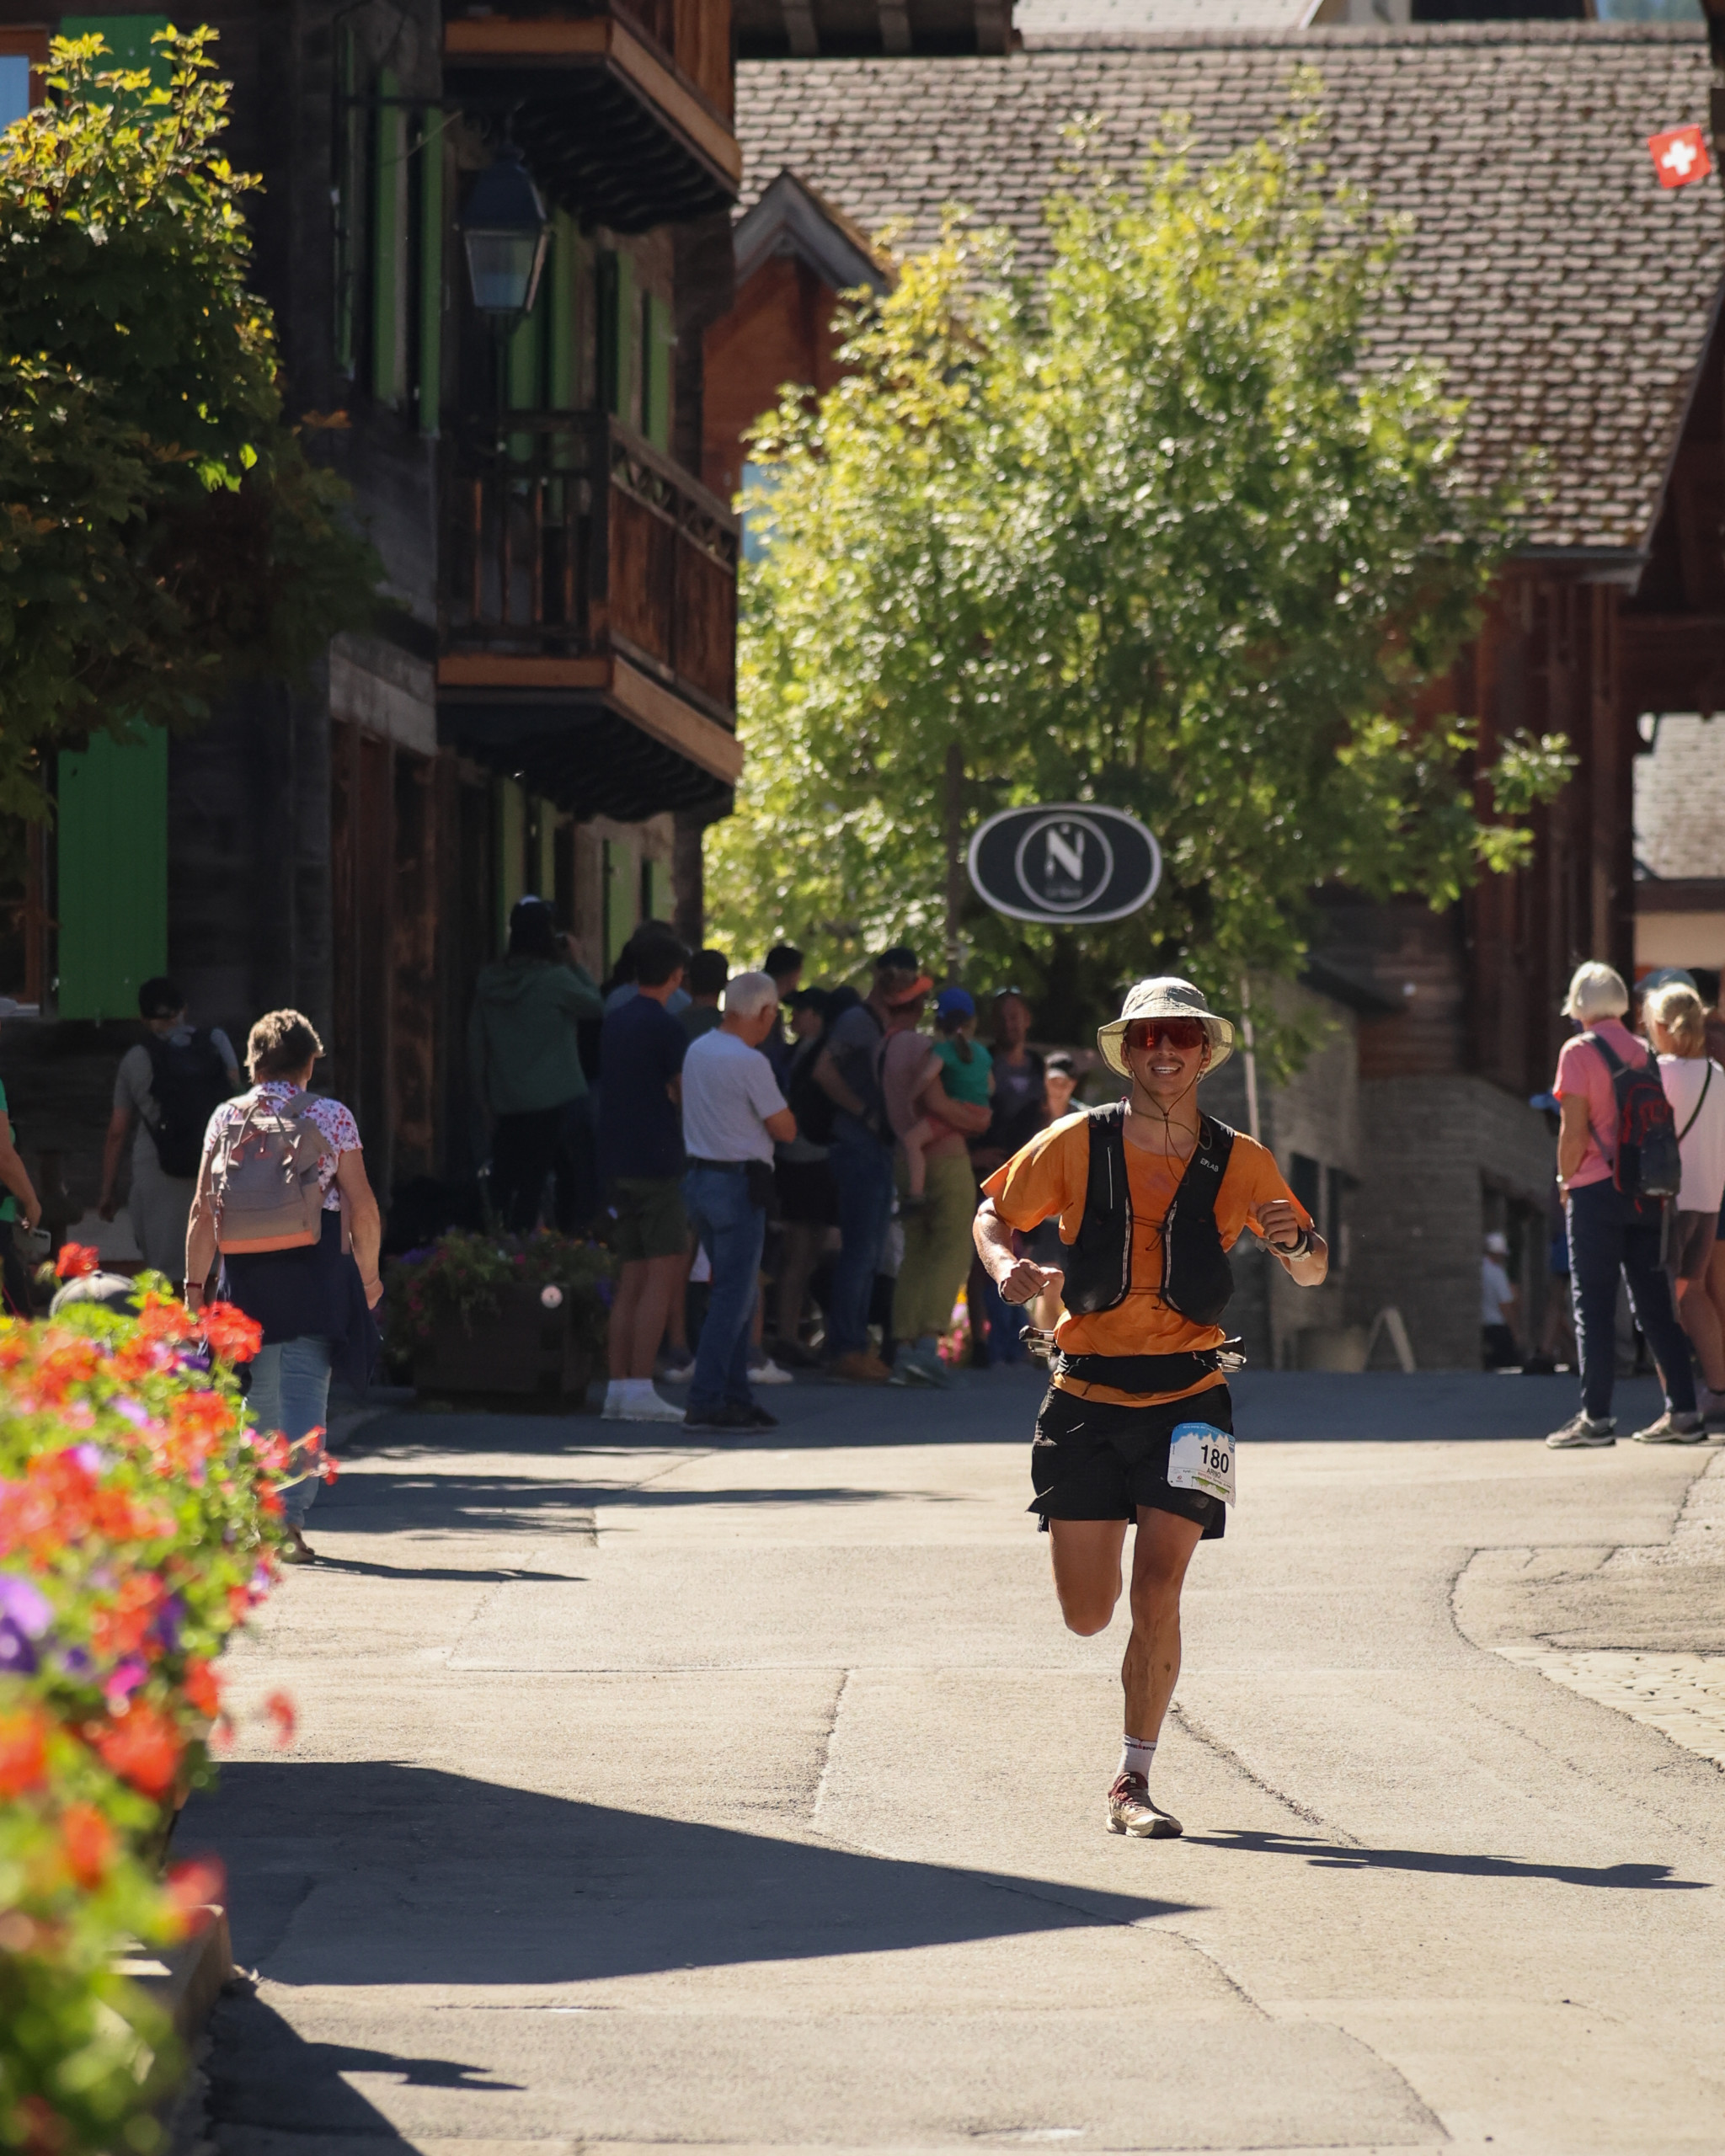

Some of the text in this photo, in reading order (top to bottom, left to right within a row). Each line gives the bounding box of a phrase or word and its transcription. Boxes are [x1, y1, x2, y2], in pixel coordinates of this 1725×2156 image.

[1045, 826, 1085, 881] N
[1200, 1444, 1229, 1474] 180
[1206, 1467, 1221, 1479] ARNO
